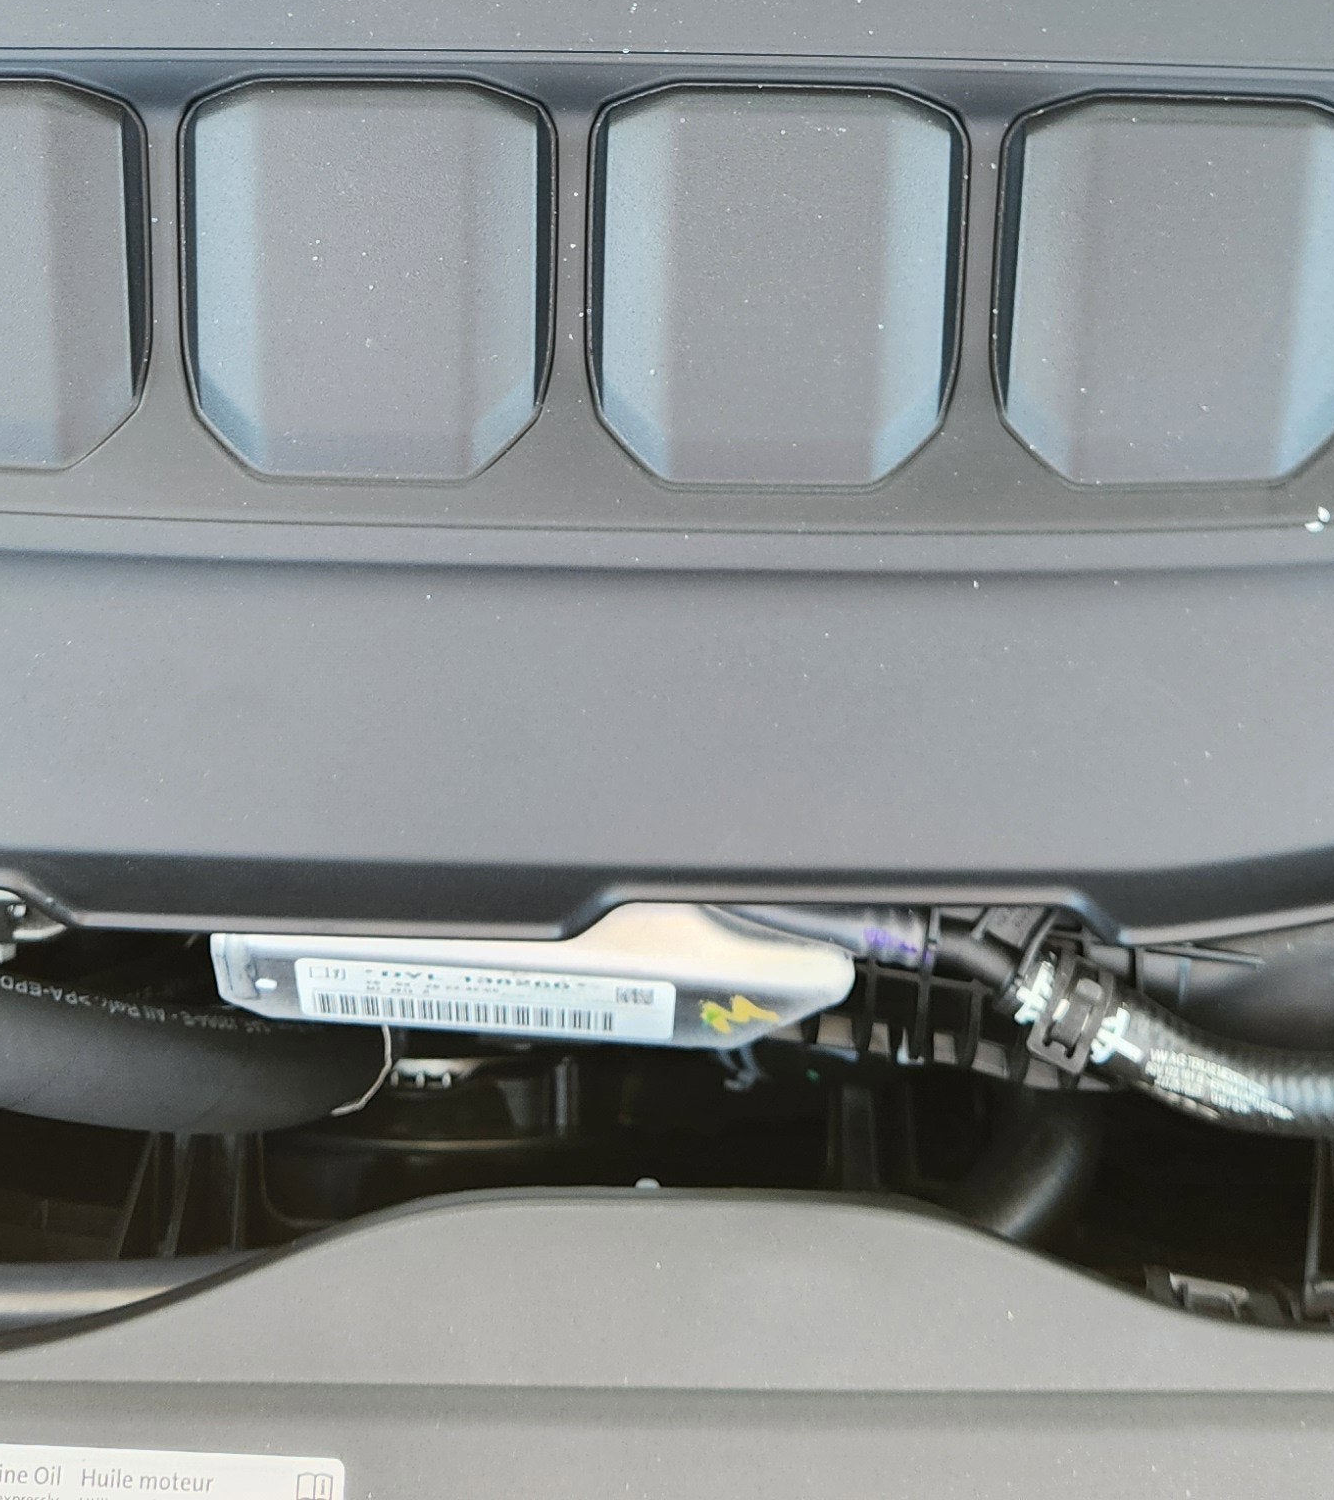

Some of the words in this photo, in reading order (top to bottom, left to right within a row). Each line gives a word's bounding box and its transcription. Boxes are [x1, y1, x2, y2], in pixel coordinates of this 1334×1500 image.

[34, 1466, 62, 1486] Oil
[81, 1468, 134, 1490] Huile
[139, 1471, 214, 1494] moteur
